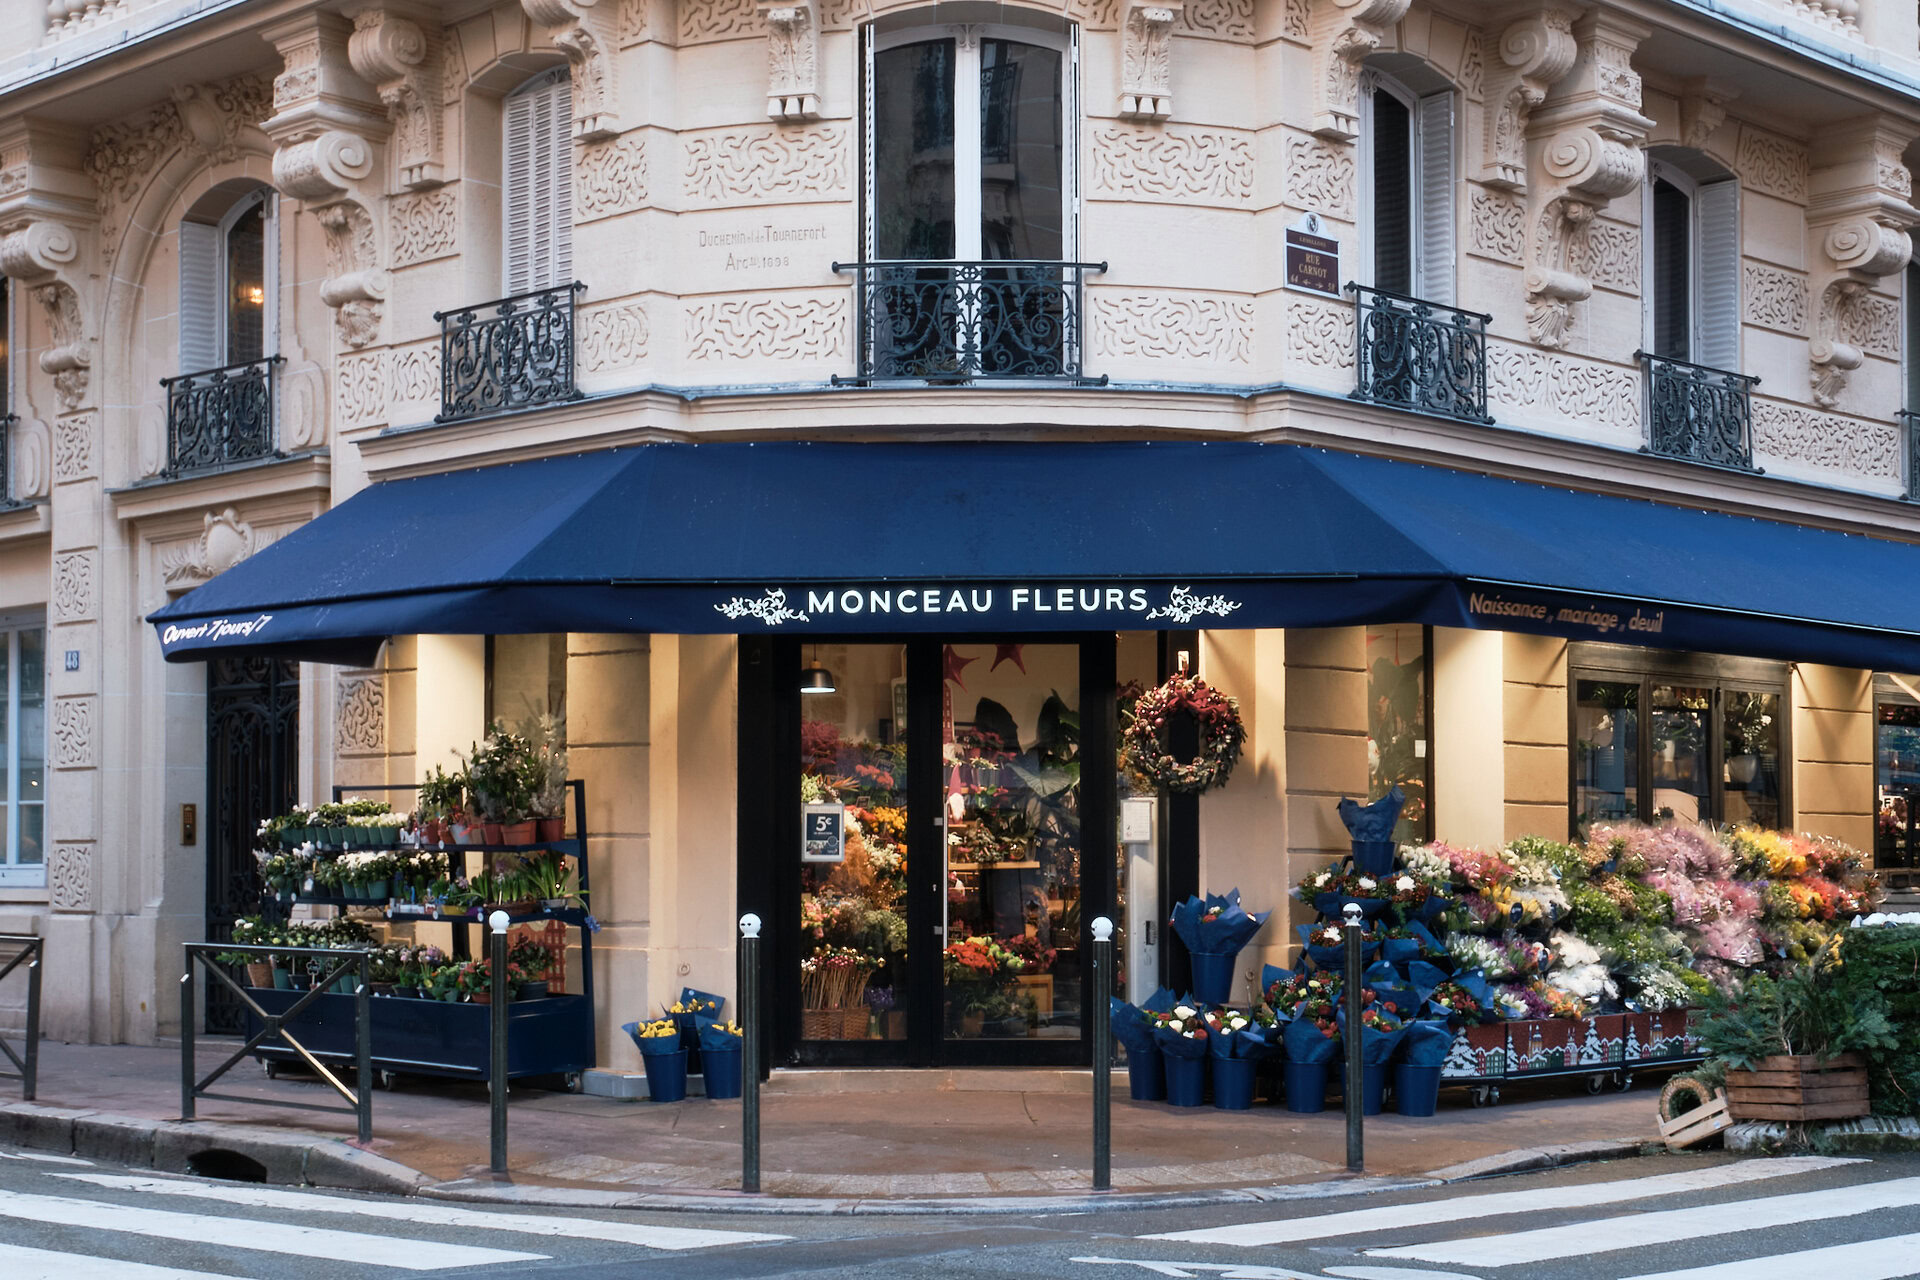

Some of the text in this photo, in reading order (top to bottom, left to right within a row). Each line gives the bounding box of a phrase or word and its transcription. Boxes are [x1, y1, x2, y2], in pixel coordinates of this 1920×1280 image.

[1305, 253, 1320, 265] RUE
[1298, 264, 1327, 279] CARNOT
[807, 588, 1149, 614] MONCEAU FLEURS
[1627, 608, 1663, 632] deuil
[163, 625, 208, 645] Ouvert
[66, 652, 78, 669] 48
